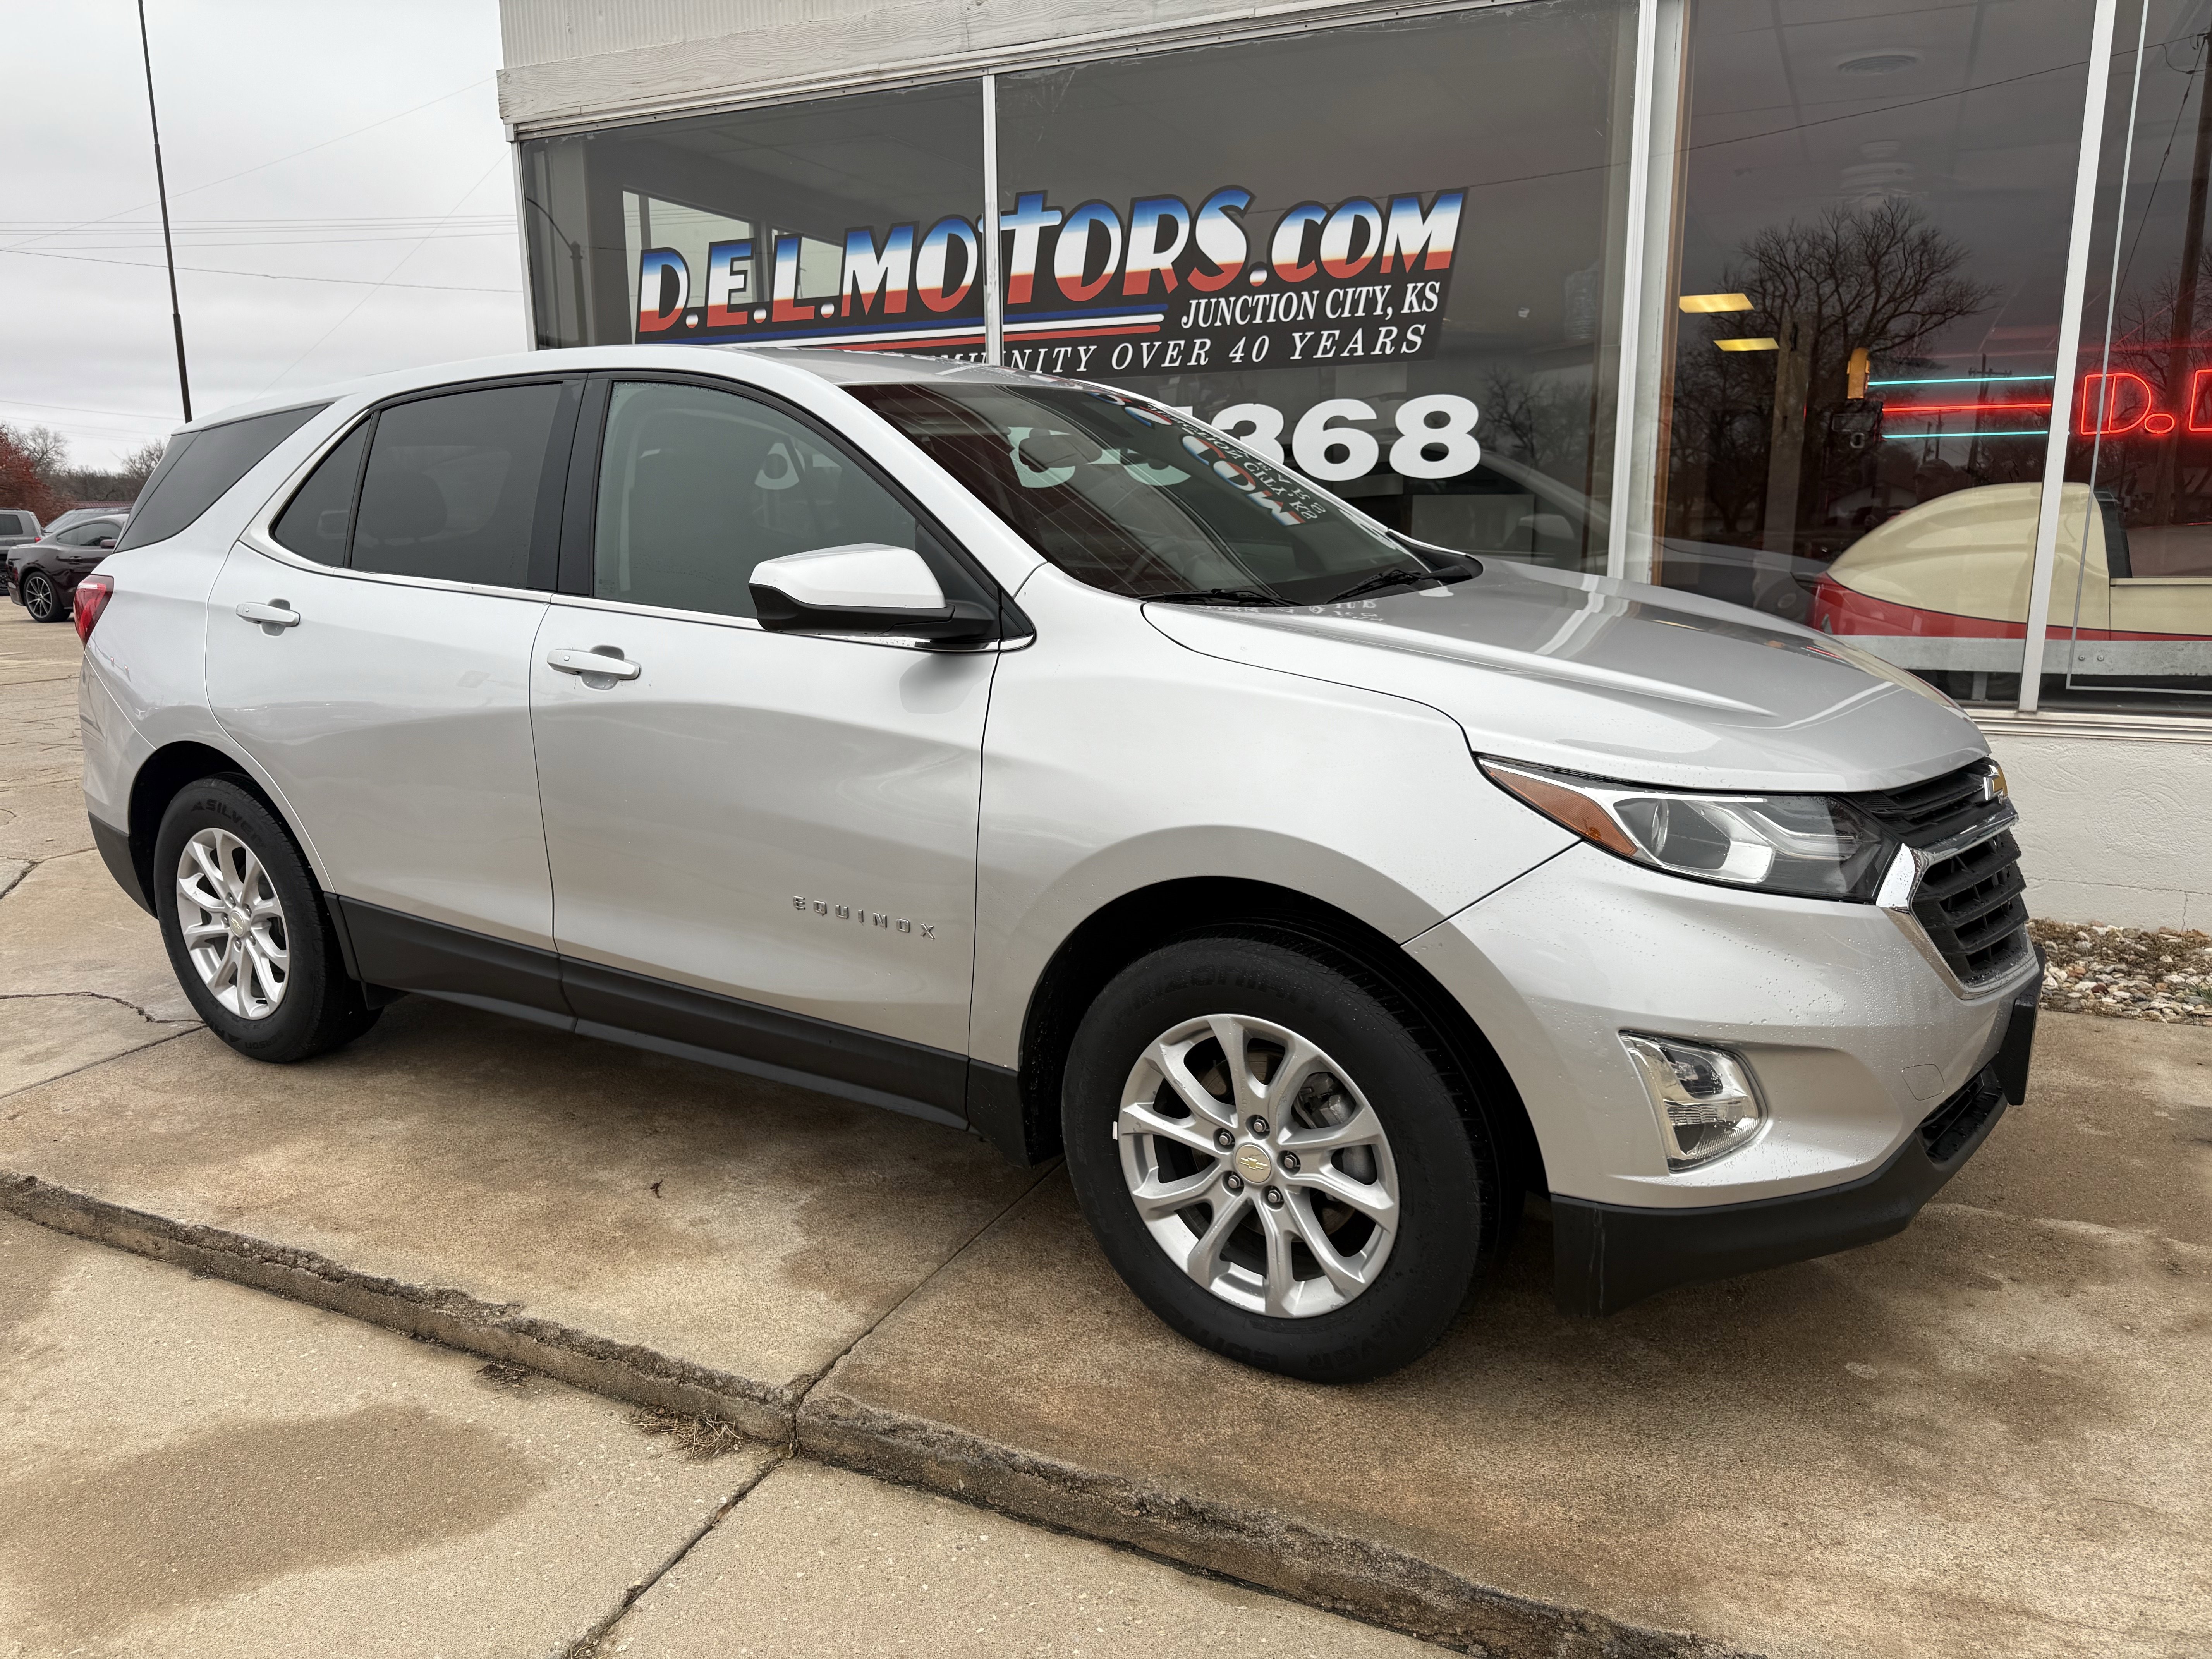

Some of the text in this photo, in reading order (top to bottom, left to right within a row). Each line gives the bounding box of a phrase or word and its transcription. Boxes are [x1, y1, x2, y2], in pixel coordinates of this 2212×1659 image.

[1181, 280, 1441, 329] JUNCTION CITY, KS
[1111, 338, 1212, 370] OVER
[1229, 335, 1270, 364] 40
[1290, 324, 1427, 360] YEARS
[1172, 394, 1481, 481] 368
[793, 895, 935, 940] EQUINOX
